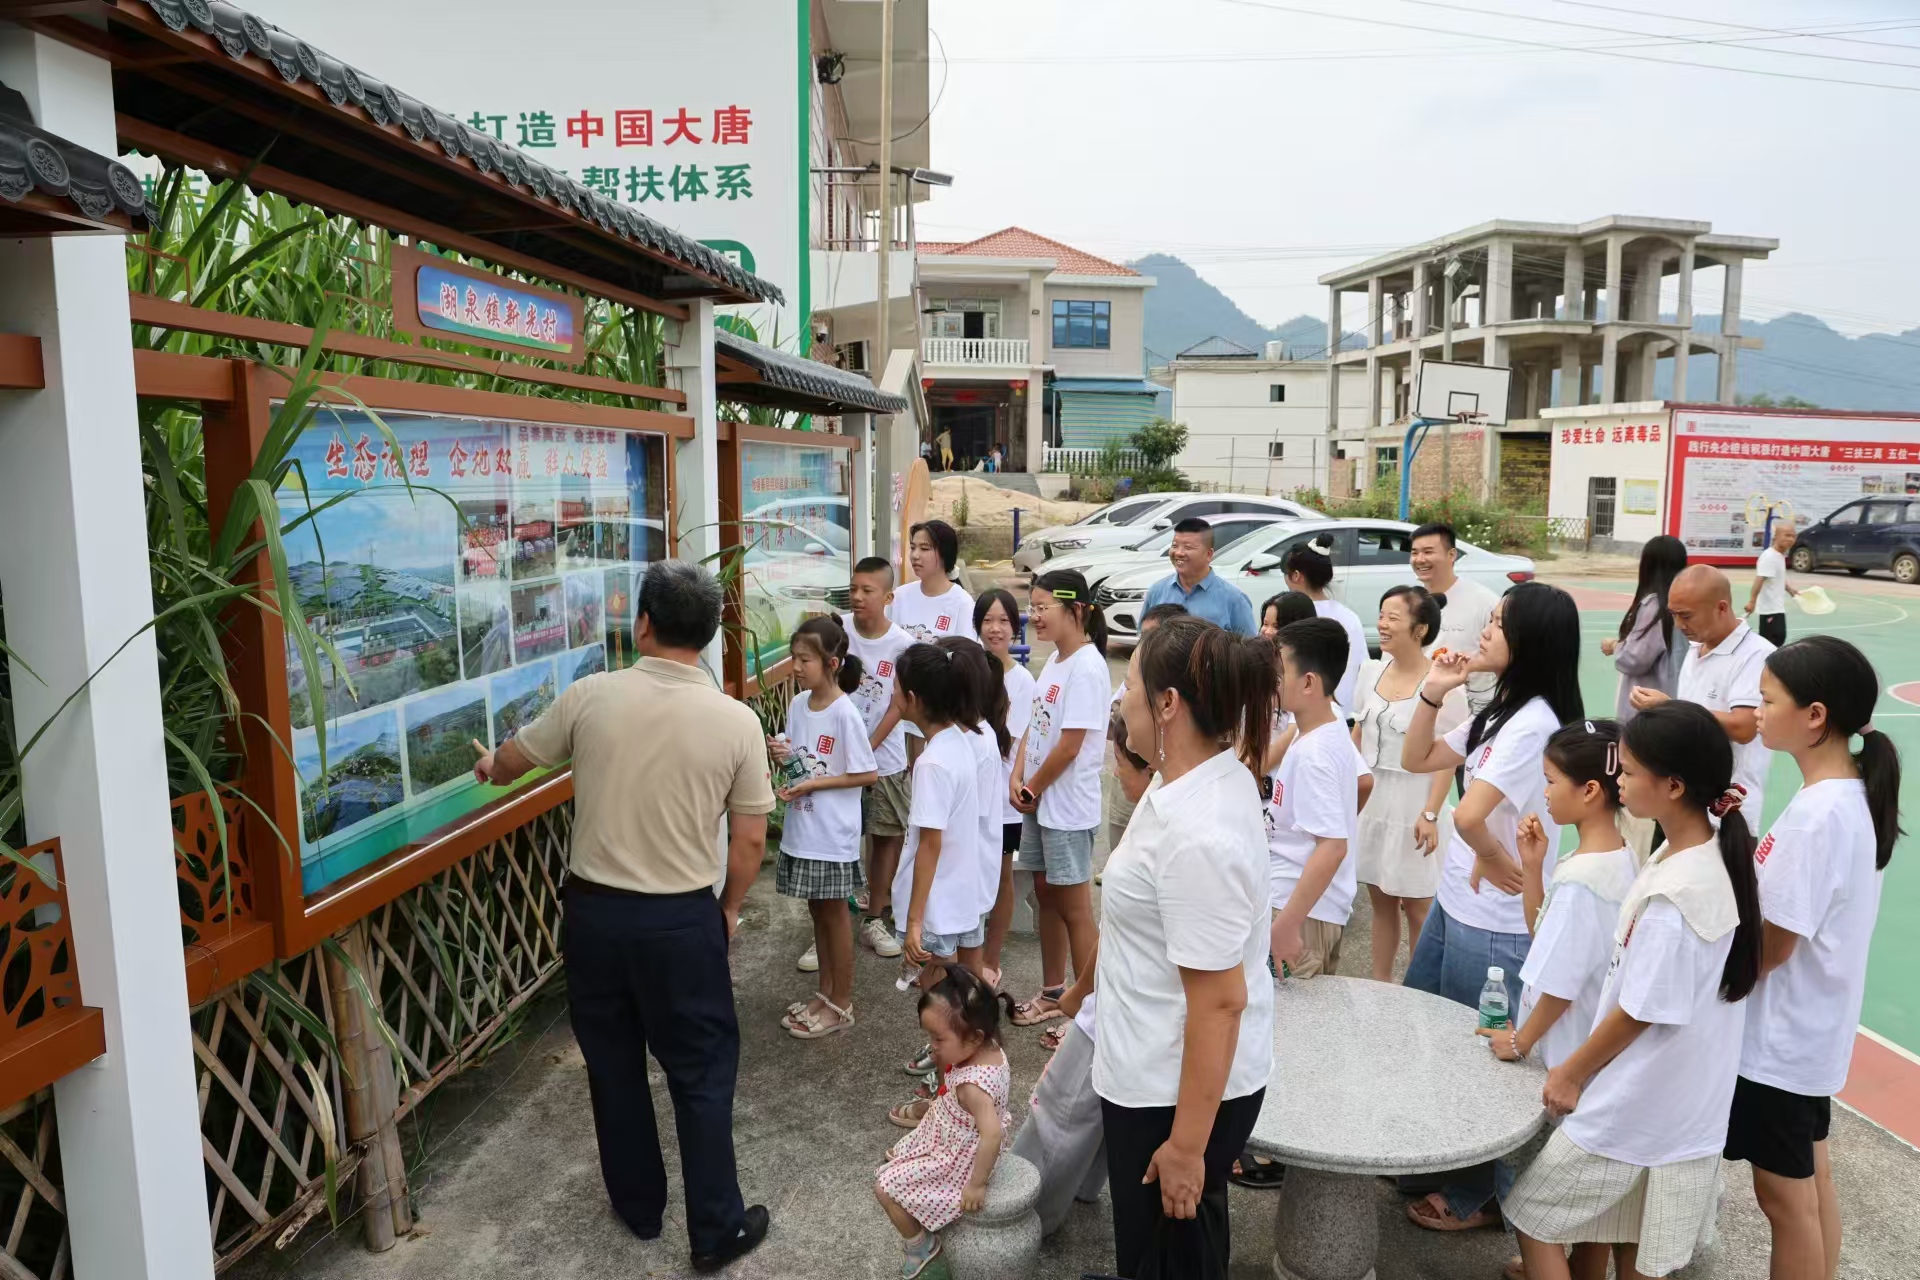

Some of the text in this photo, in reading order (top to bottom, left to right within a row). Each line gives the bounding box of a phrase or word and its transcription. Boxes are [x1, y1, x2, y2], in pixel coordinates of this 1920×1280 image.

[450, 105, 753, 149] 打造中国大唐
[560, 164, 753, 202] 帮扶体系
[440, 282, 557, 343] 湖泉镇新光村
[325, 432, 430, 481] 生态治理
[1561, 425, 1662, 445] 珍爱生命 远离毒品
